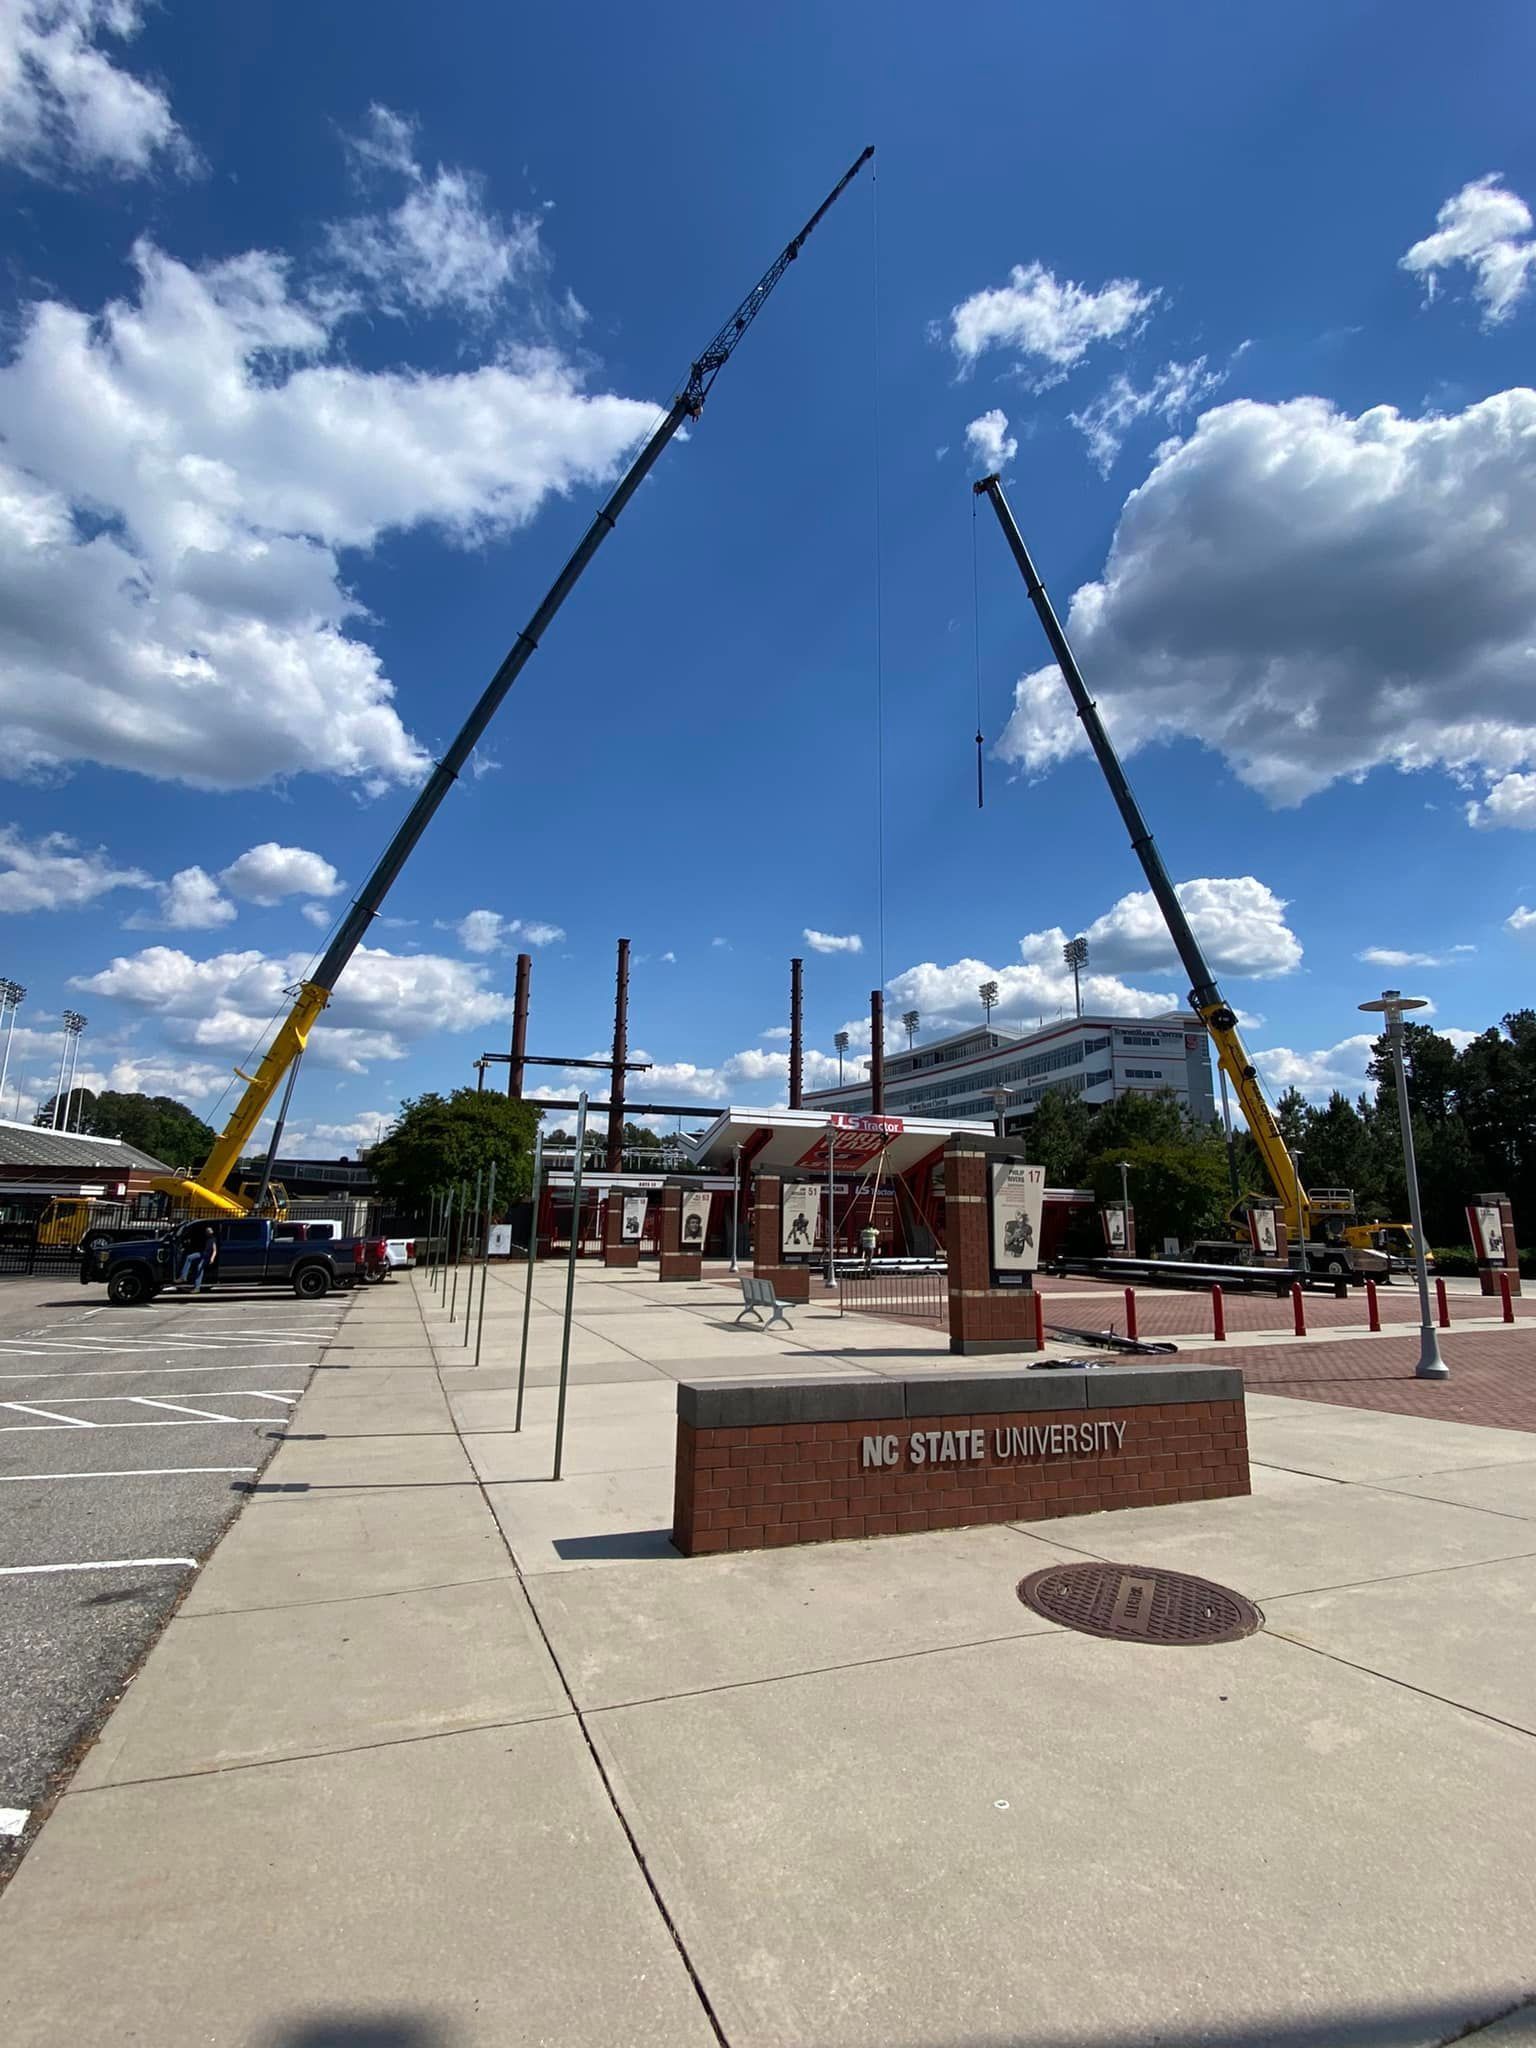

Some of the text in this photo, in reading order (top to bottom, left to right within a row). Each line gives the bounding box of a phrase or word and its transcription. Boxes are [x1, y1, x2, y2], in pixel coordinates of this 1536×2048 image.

[838, 1116, 900, 1133] LS Tractor
[1028, 1170, 1040, 1184] 17
[807, 1187, 818, 1196] 51
[871, 1187, 896, 1197] Tactor
[862, 1420, 1127, 1467] NC STATE UNIVERSITY
